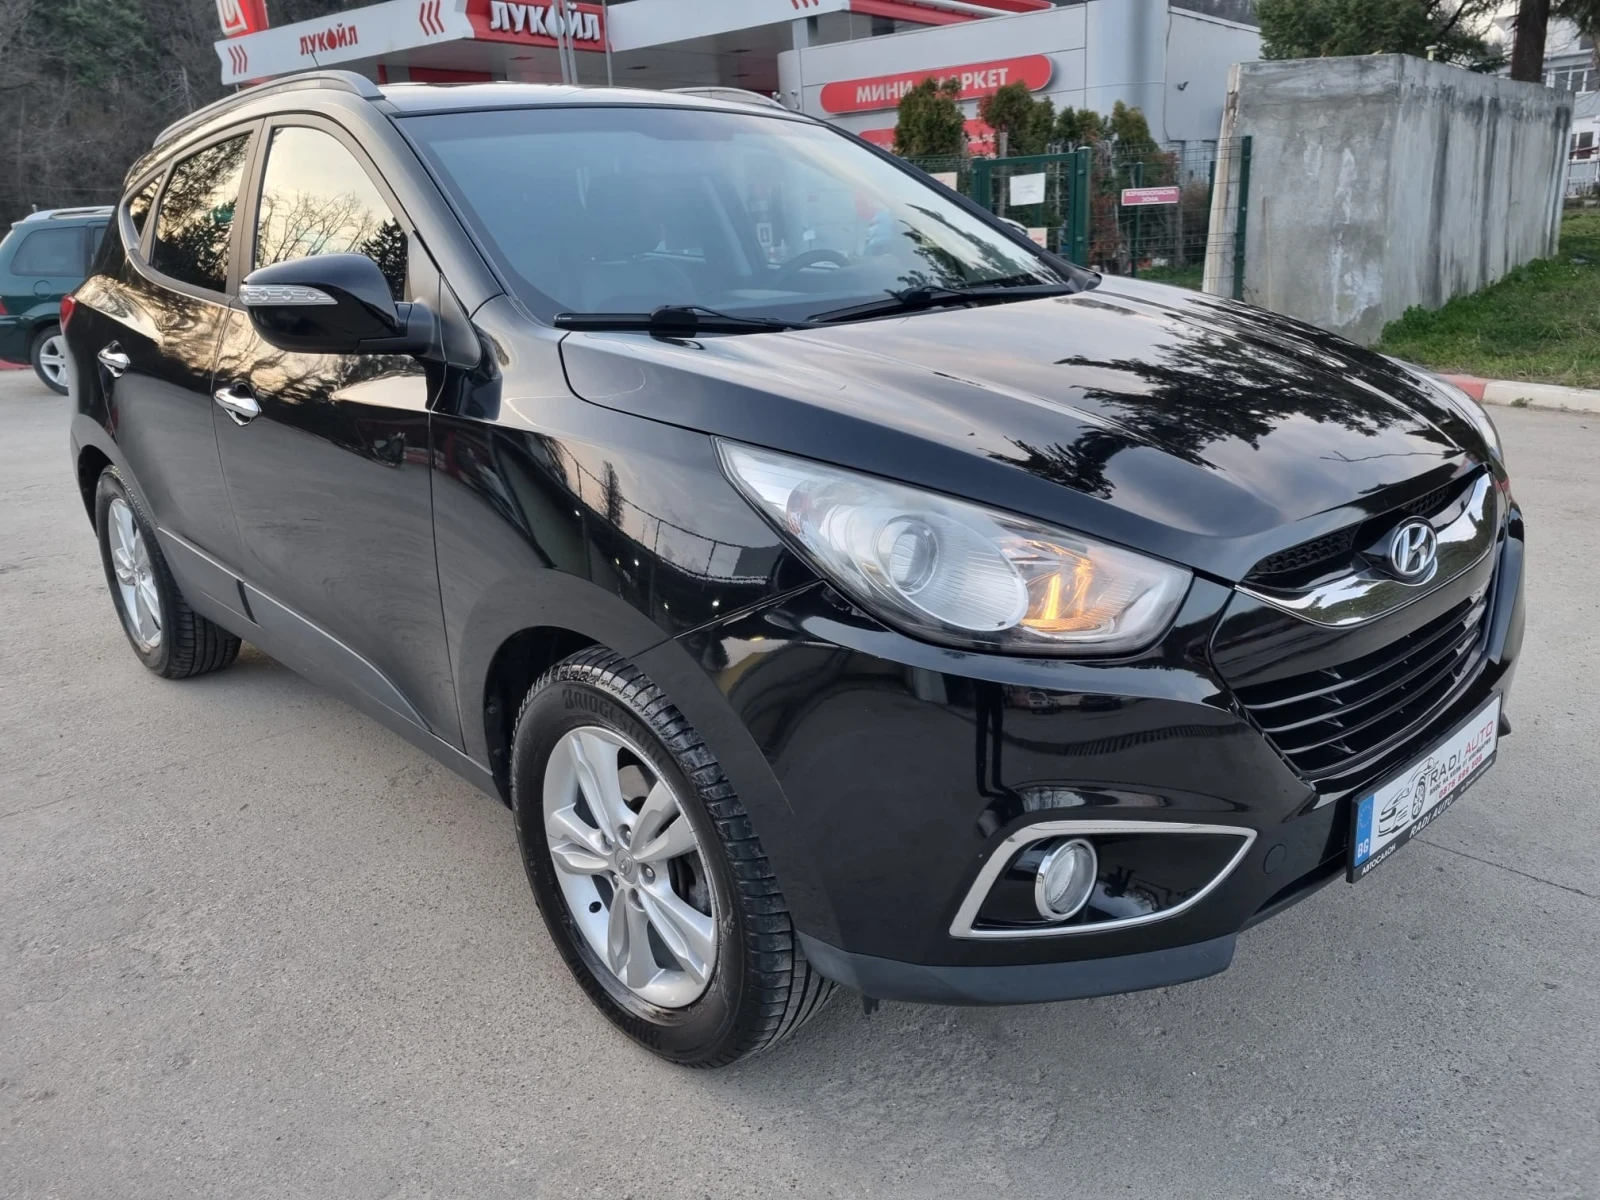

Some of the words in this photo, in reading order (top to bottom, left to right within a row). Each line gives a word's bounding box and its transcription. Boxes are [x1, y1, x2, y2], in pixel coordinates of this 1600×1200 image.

[299, 22, 358, 55] ЛУКОЙЛ
[490, 1, 600, 41] ЛУКОЙЛ
[856, 80, 913, 103] МИНИ
[1429, 749, 1461, 787] RADI
[1464, 720, 1493, 758] AUTO
[1409, 816, 1430, 838] RADI
[1431, 795, 1454, 819] AUTO
[1357, 838, 1369, 858] BG
